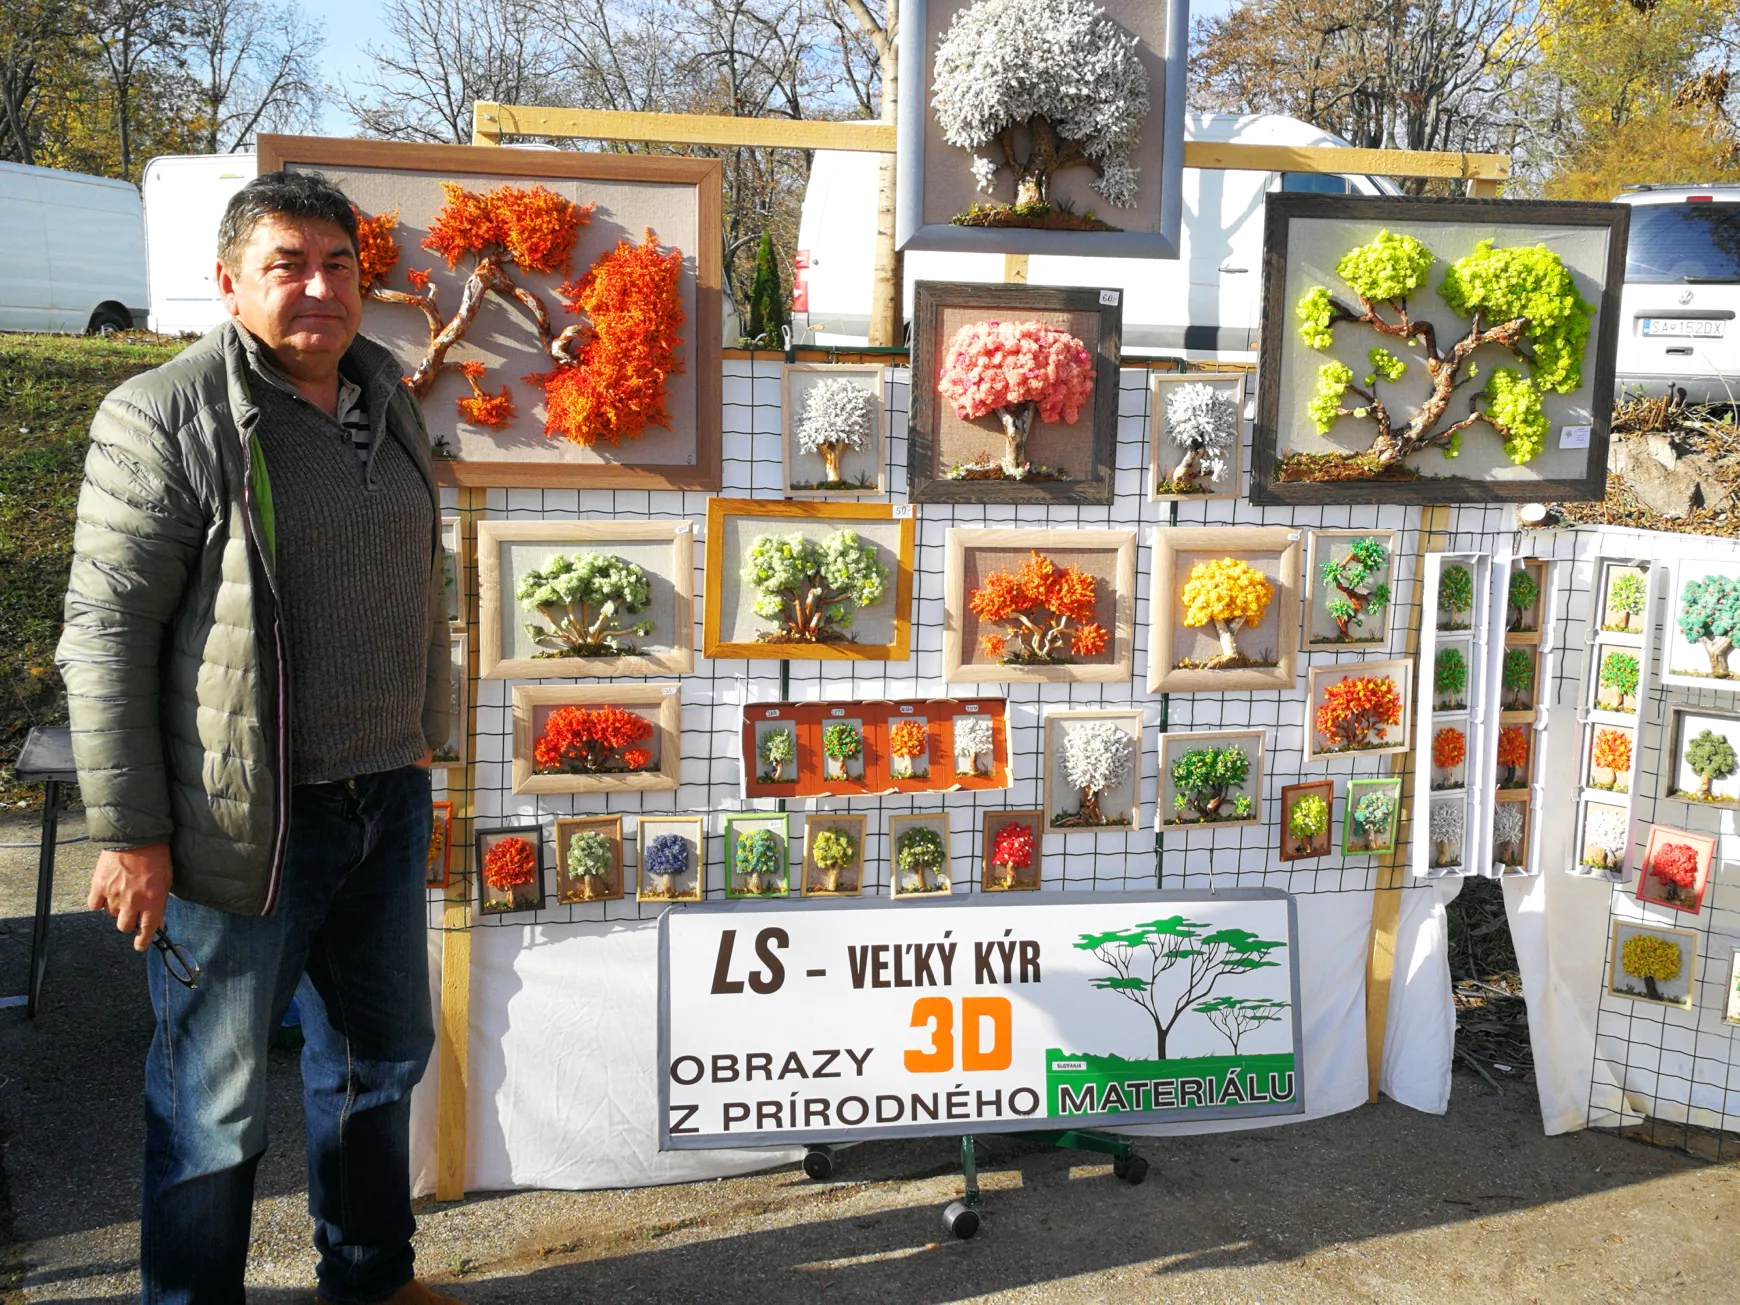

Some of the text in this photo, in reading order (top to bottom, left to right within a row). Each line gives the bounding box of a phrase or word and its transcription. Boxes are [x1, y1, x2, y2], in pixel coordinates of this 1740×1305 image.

[1652, 321, 1722, 334] SA 152DX
[710, 927, 789, 995] LS
[847, 930, 957, 989] VEĽKÝ
[974, 928, 1041, 985] KÝR
[670, 1047, 875, 1086] OBRAZY
[904, 996, 1012, 1073] 3D
[669, 1067, 1295, 1135] Z PRÍRODNÉHO MATERIÁLU
